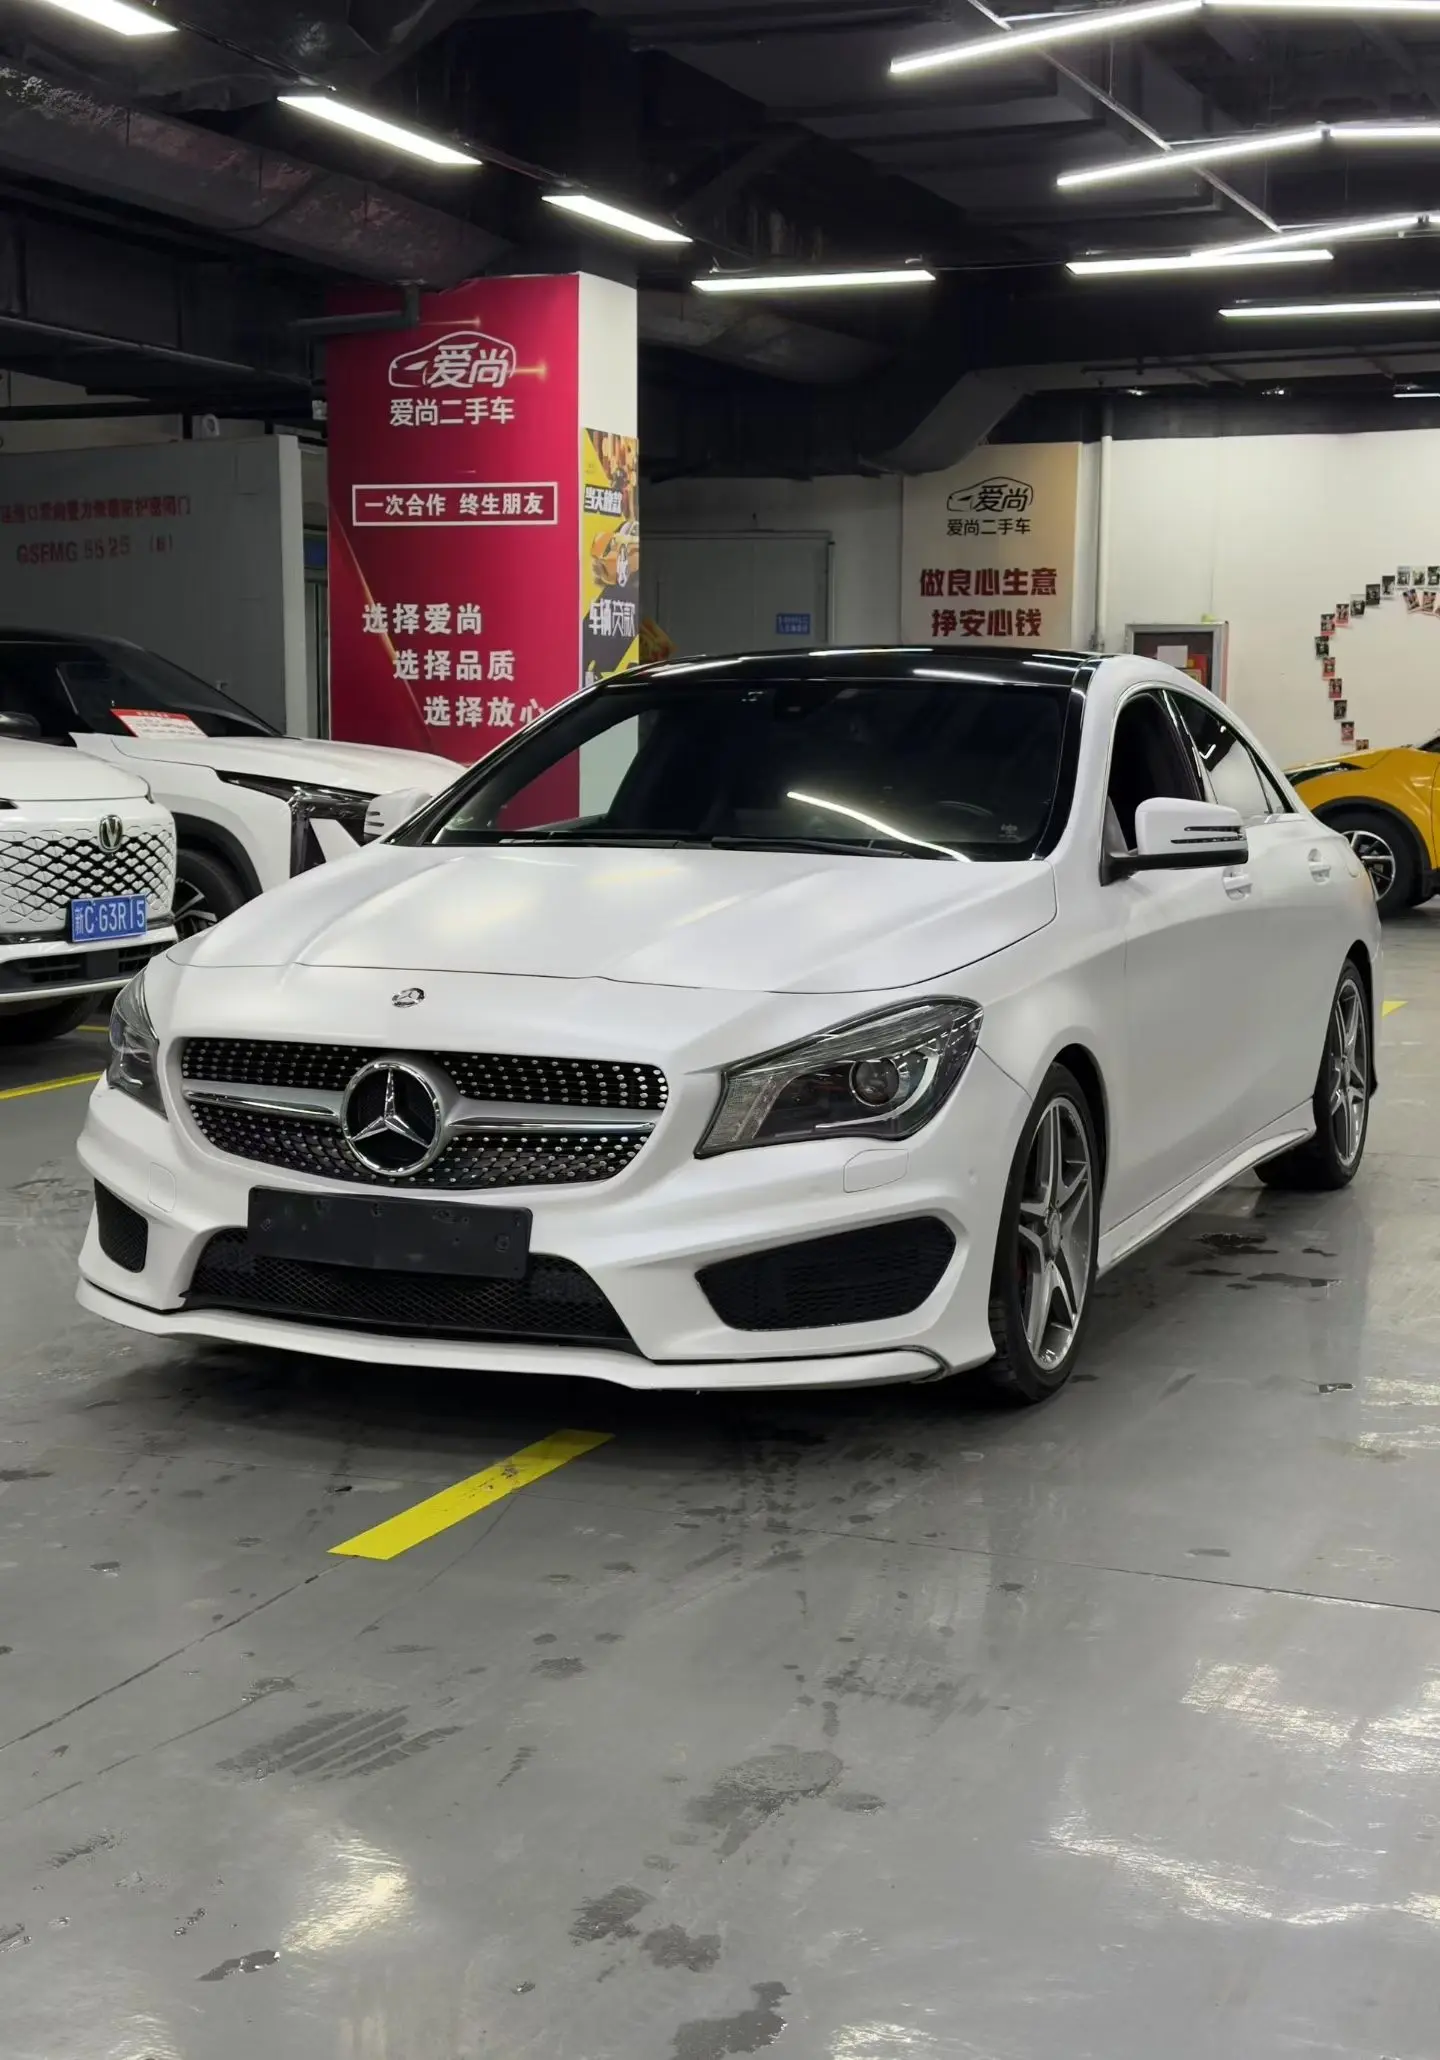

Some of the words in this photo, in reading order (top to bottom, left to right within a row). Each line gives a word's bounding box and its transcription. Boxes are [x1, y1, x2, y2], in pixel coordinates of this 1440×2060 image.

[428, 342, 512, 389] 爱尚
[389, 396, 515, 427] 爱尚二手车
[364, 492, 447, 517] 一次合作
[459, 491, 545, 516] 终生朋友
[973, 483, 1029, 513] 爱尚
[946, 518, 1032, 537] 爱尚二手车
[919, 567, 1058, 597] 做良心生意
[361, 602, 484, 635] 选择爱尚
[588, 597, 636, 637] 车辆贷款
[930, 608, 1043, 638] 挣安心钱
[392, 649, 517, 683] 选择品质
[423, 696, 547, 729] 选择放心
